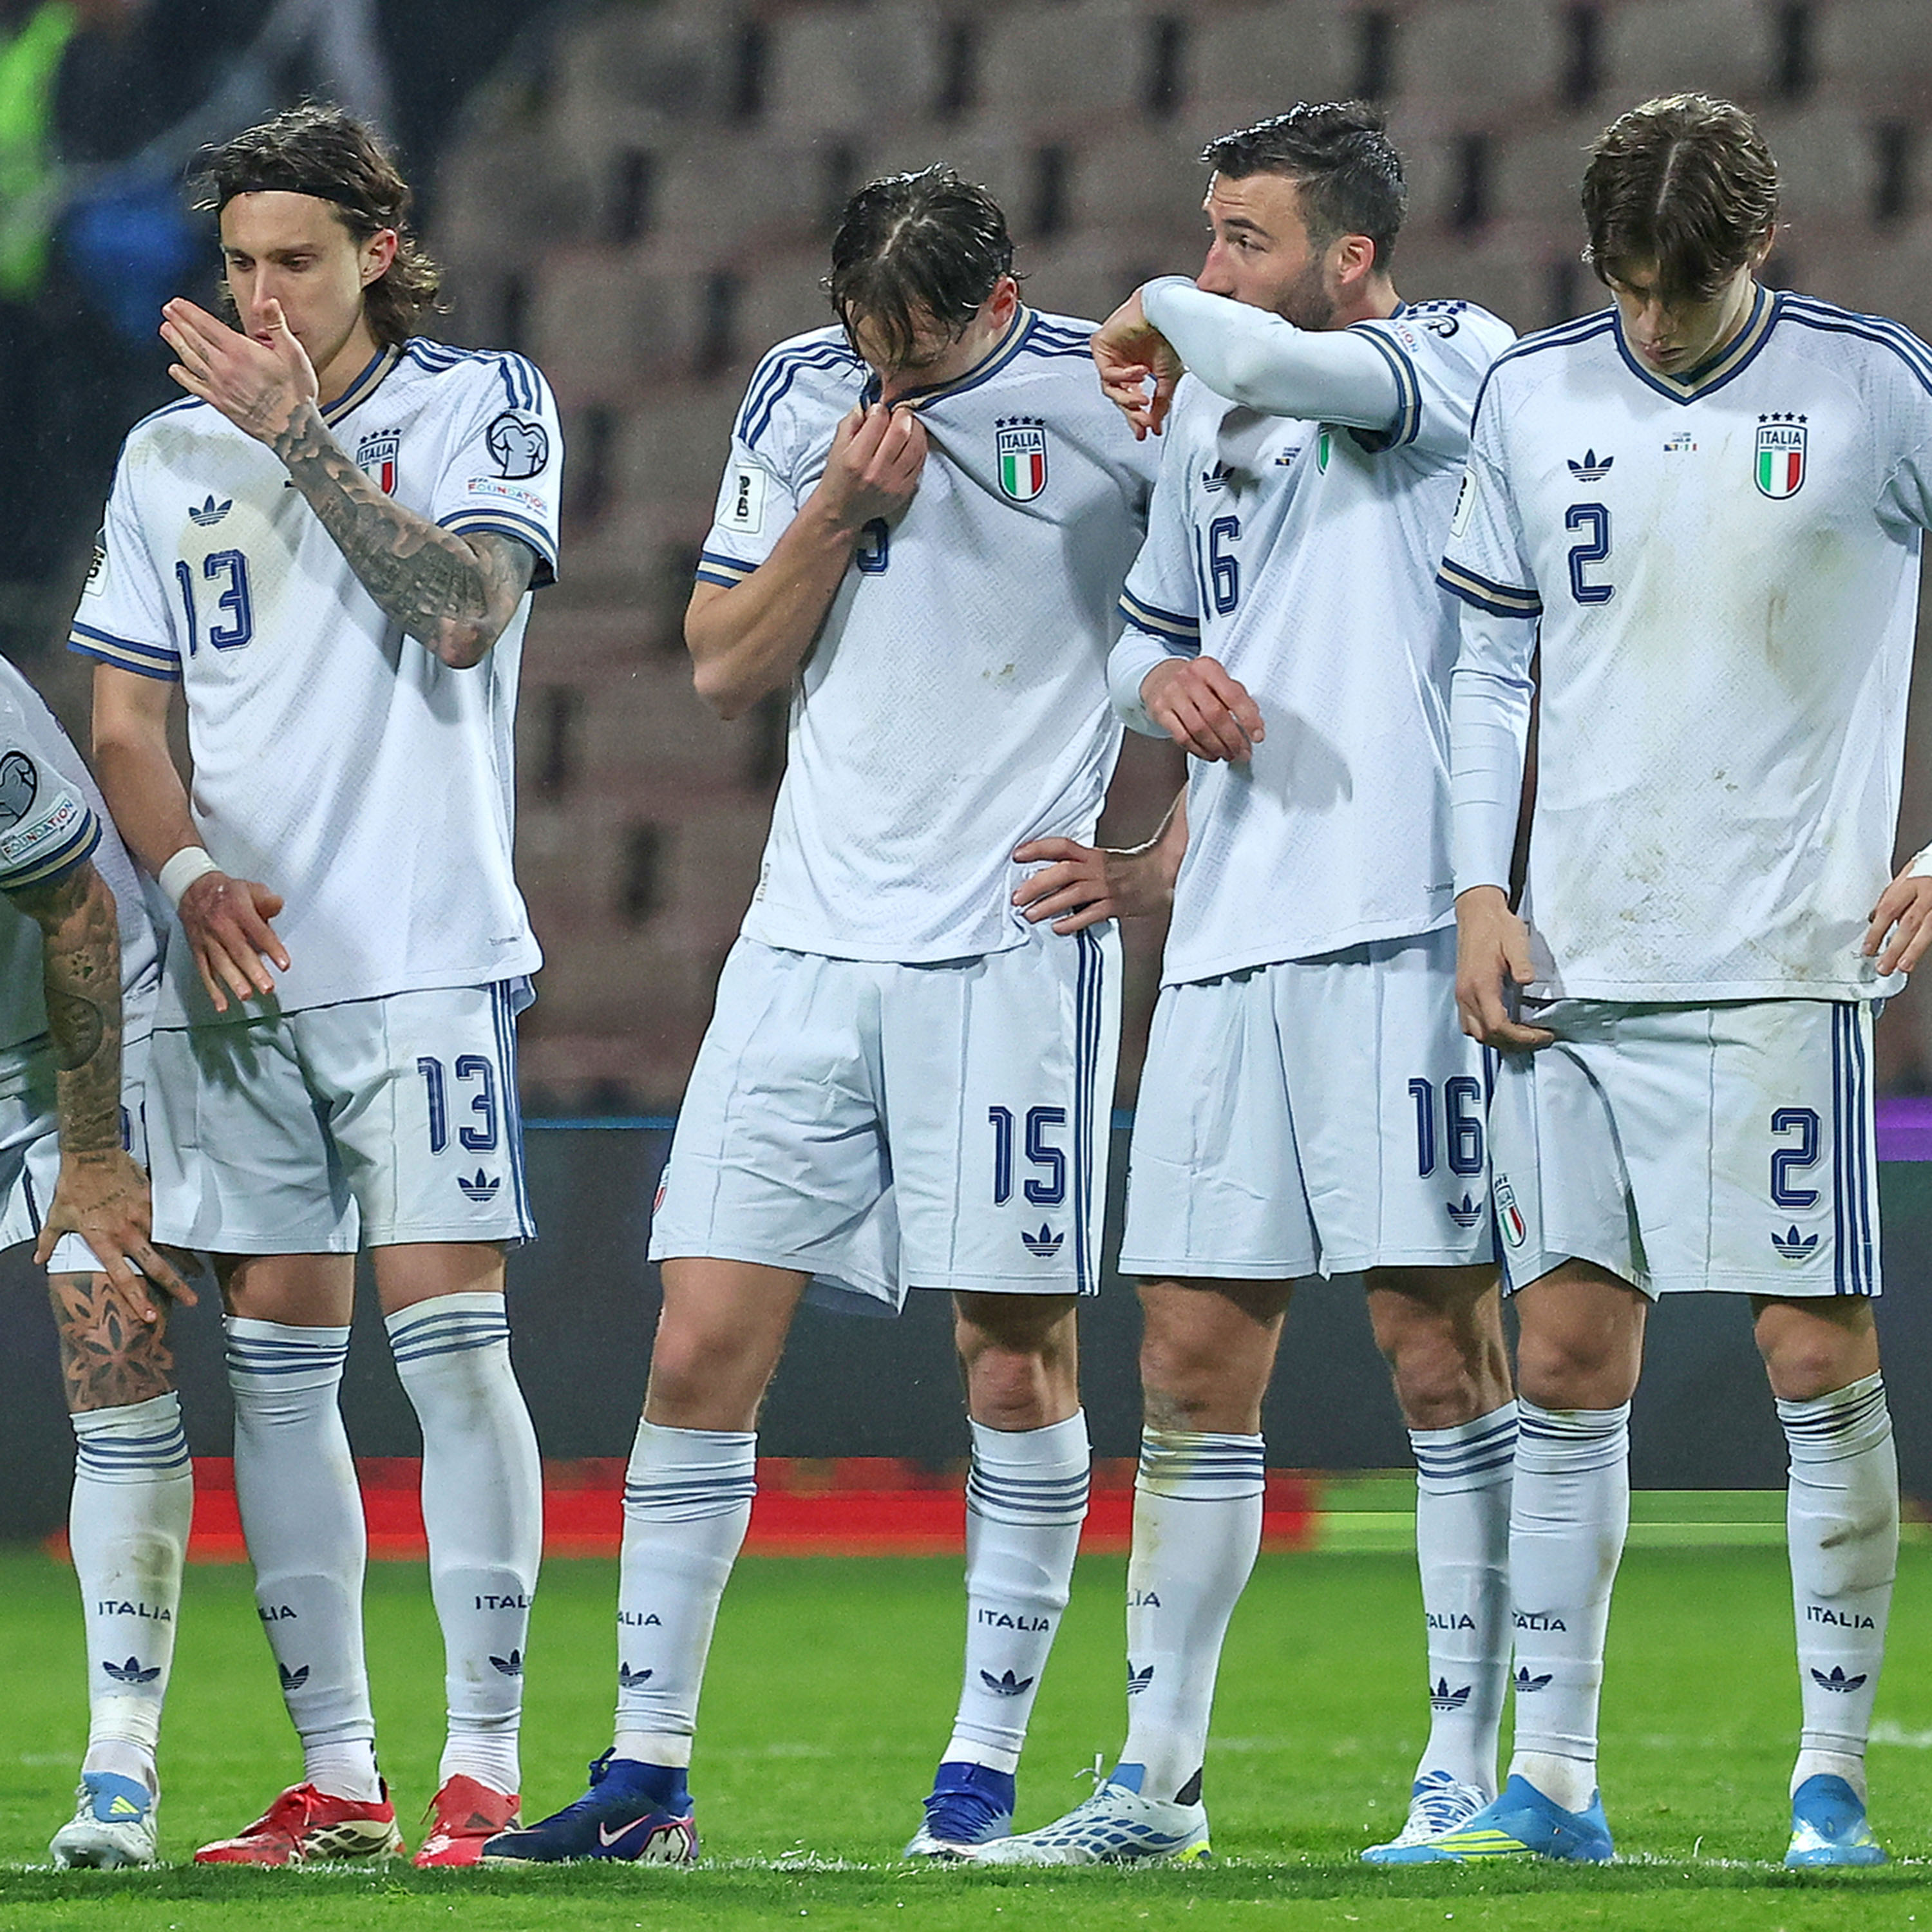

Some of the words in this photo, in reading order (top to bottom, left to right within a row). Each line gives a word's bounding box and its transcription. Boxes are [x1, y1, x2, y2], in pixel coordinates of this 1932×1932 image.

[360, 442, 393, 462] ITALIA
[1001, 432, 1041, 448] ITALIA
[1761, 431, 1801, 444] ITALIA
[1195, 515, 1242, 624] 16
[1566, 502, 1616, 606] 2
[175, 549, 256, 659] 13
[3, 799, 73, 854] FOUNDATION
[417, 1054, 497, 1155] 13
[1408, 1076, 1484, 1179] 16
[989, 1106, 1067, 1208] 15
[1771, 1108, 1821, 1210] 2
[99, 1601, 171, 1622] ITALIA
[978, 1609, 1049, 1631] ITALIA
[1807, 1605, 1874, 1629] ITALIA
